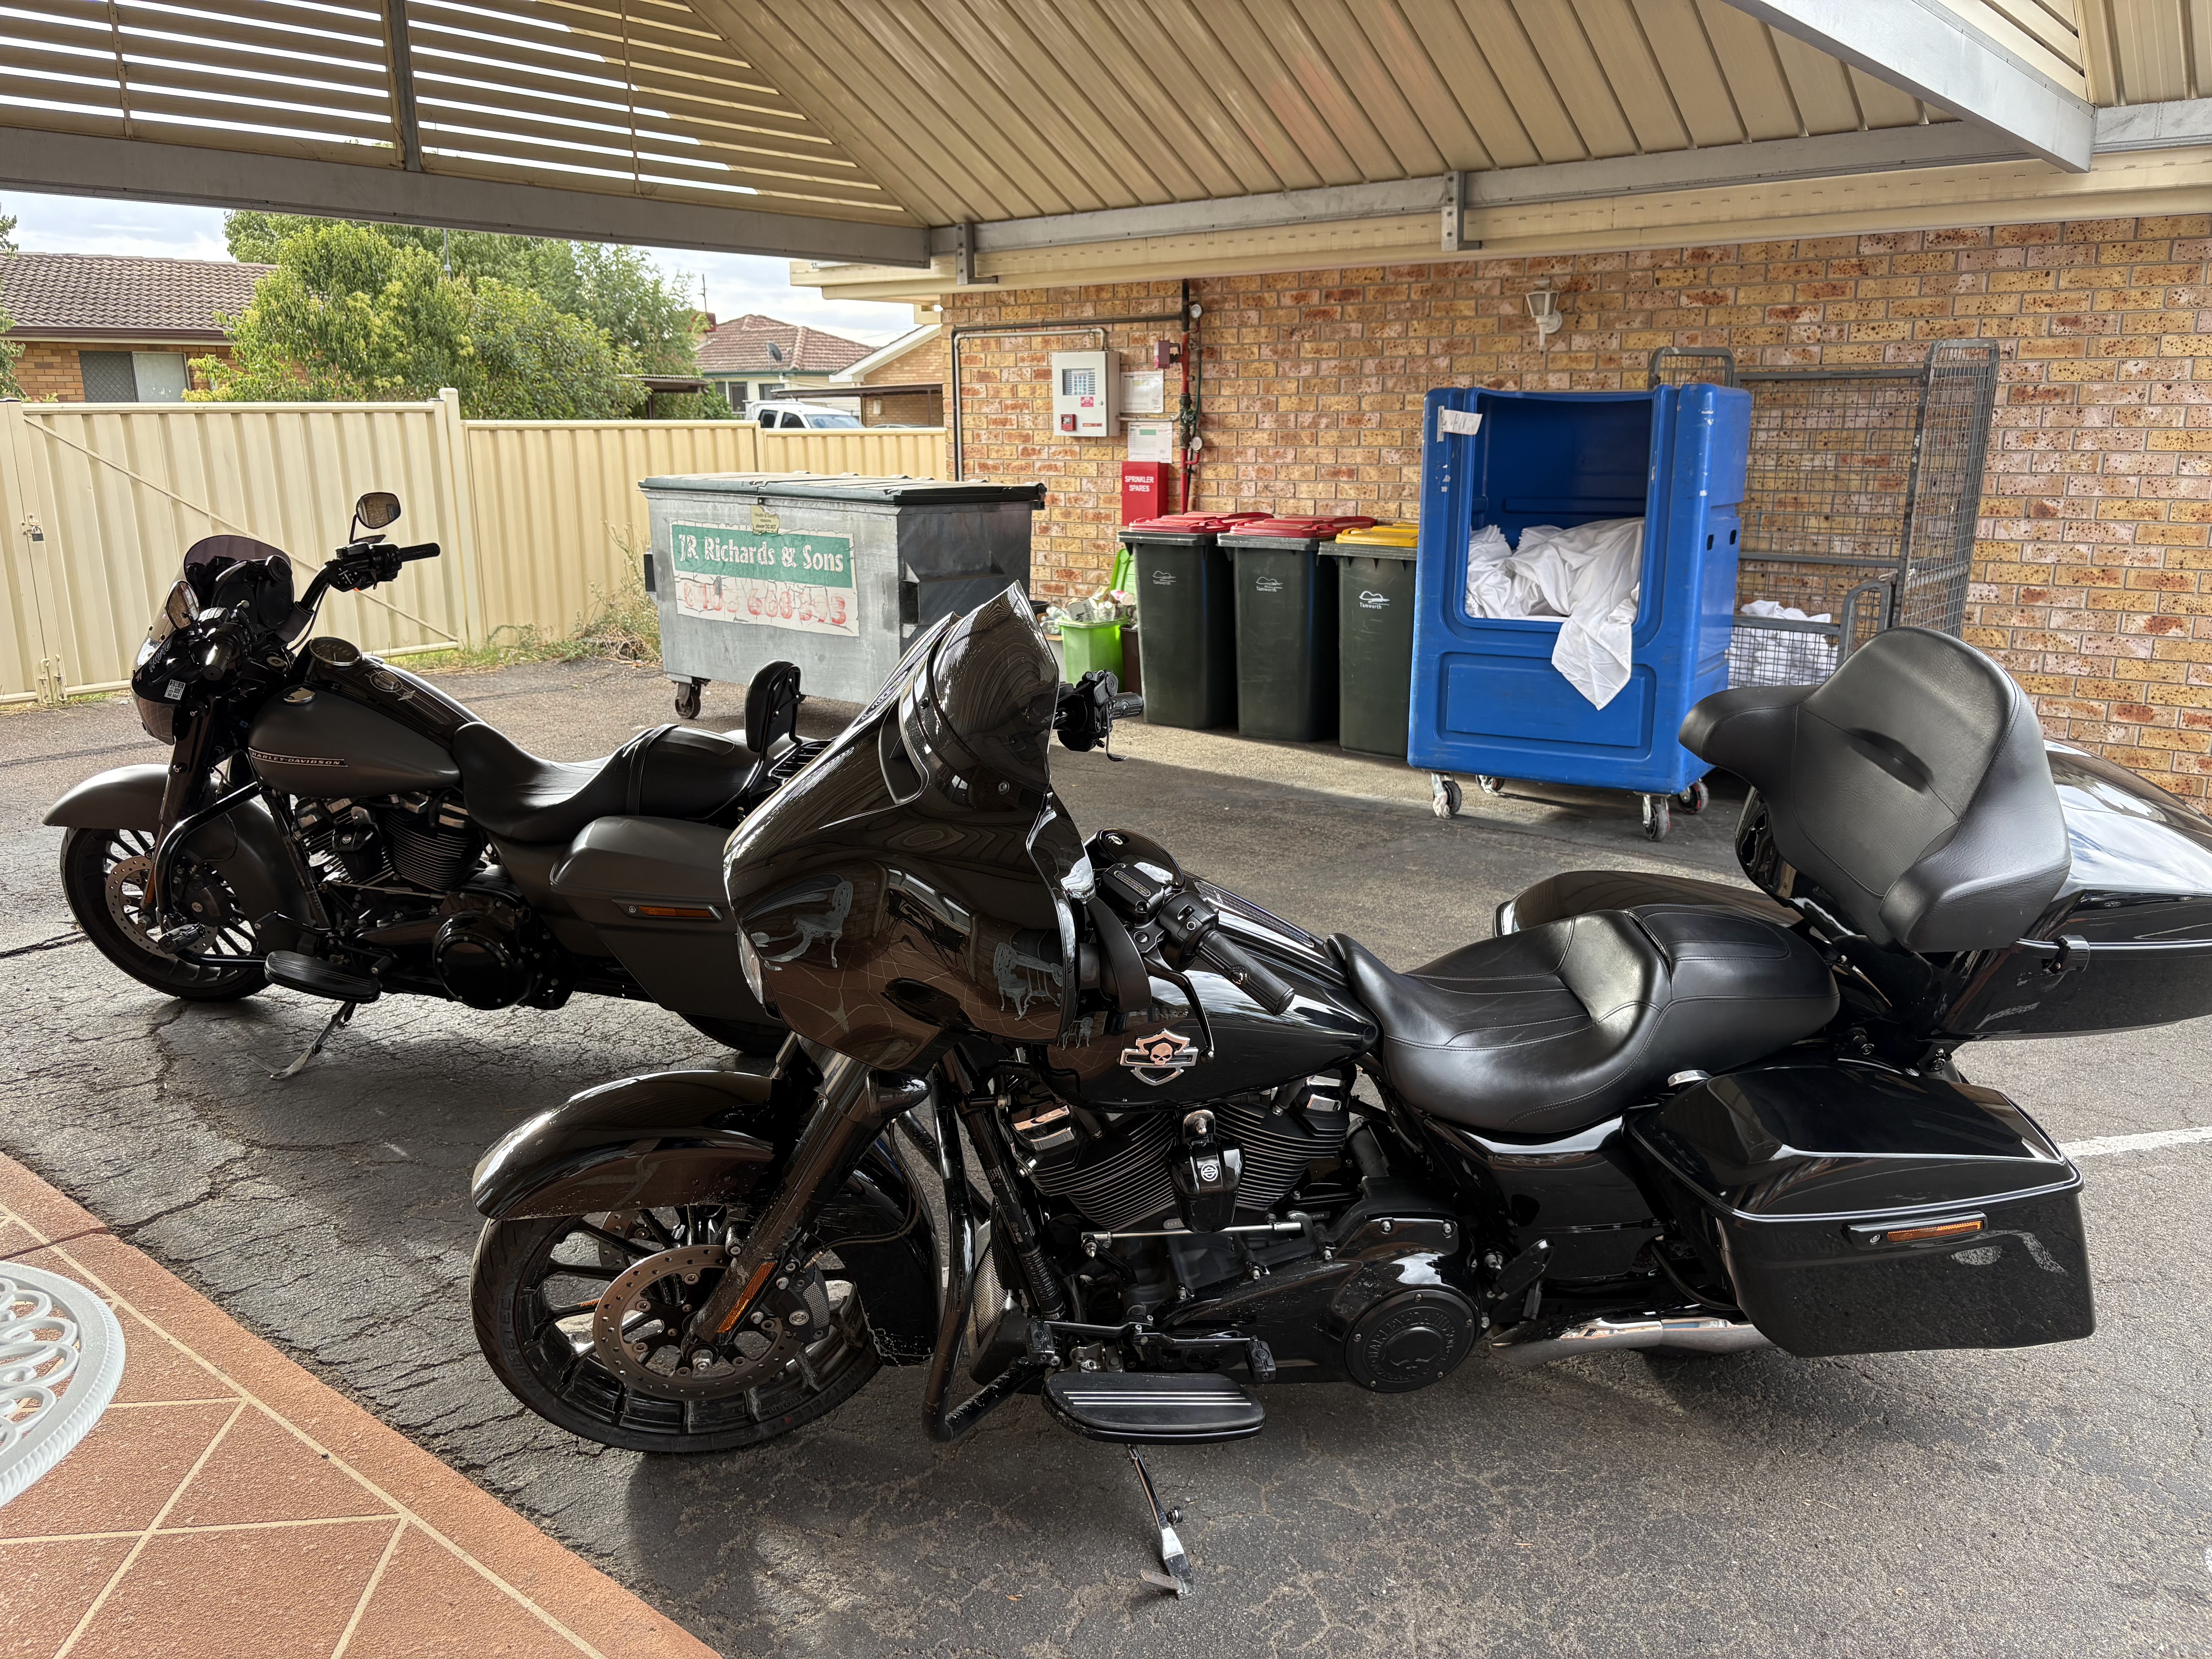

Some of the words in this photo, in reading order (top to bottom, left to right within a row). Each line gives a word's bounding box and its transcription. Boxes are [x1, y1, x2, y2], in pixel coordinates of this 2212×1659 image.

[679, 534, 699, 562] JR
[704, 537, 775, 565] Richards
[781, 546, 797, 568] &
[803, 544, 843, 572] Sons
[747, 588, 793, 619] 668
[252, 752, 340, 765] HARLEY-DAVIDSON
